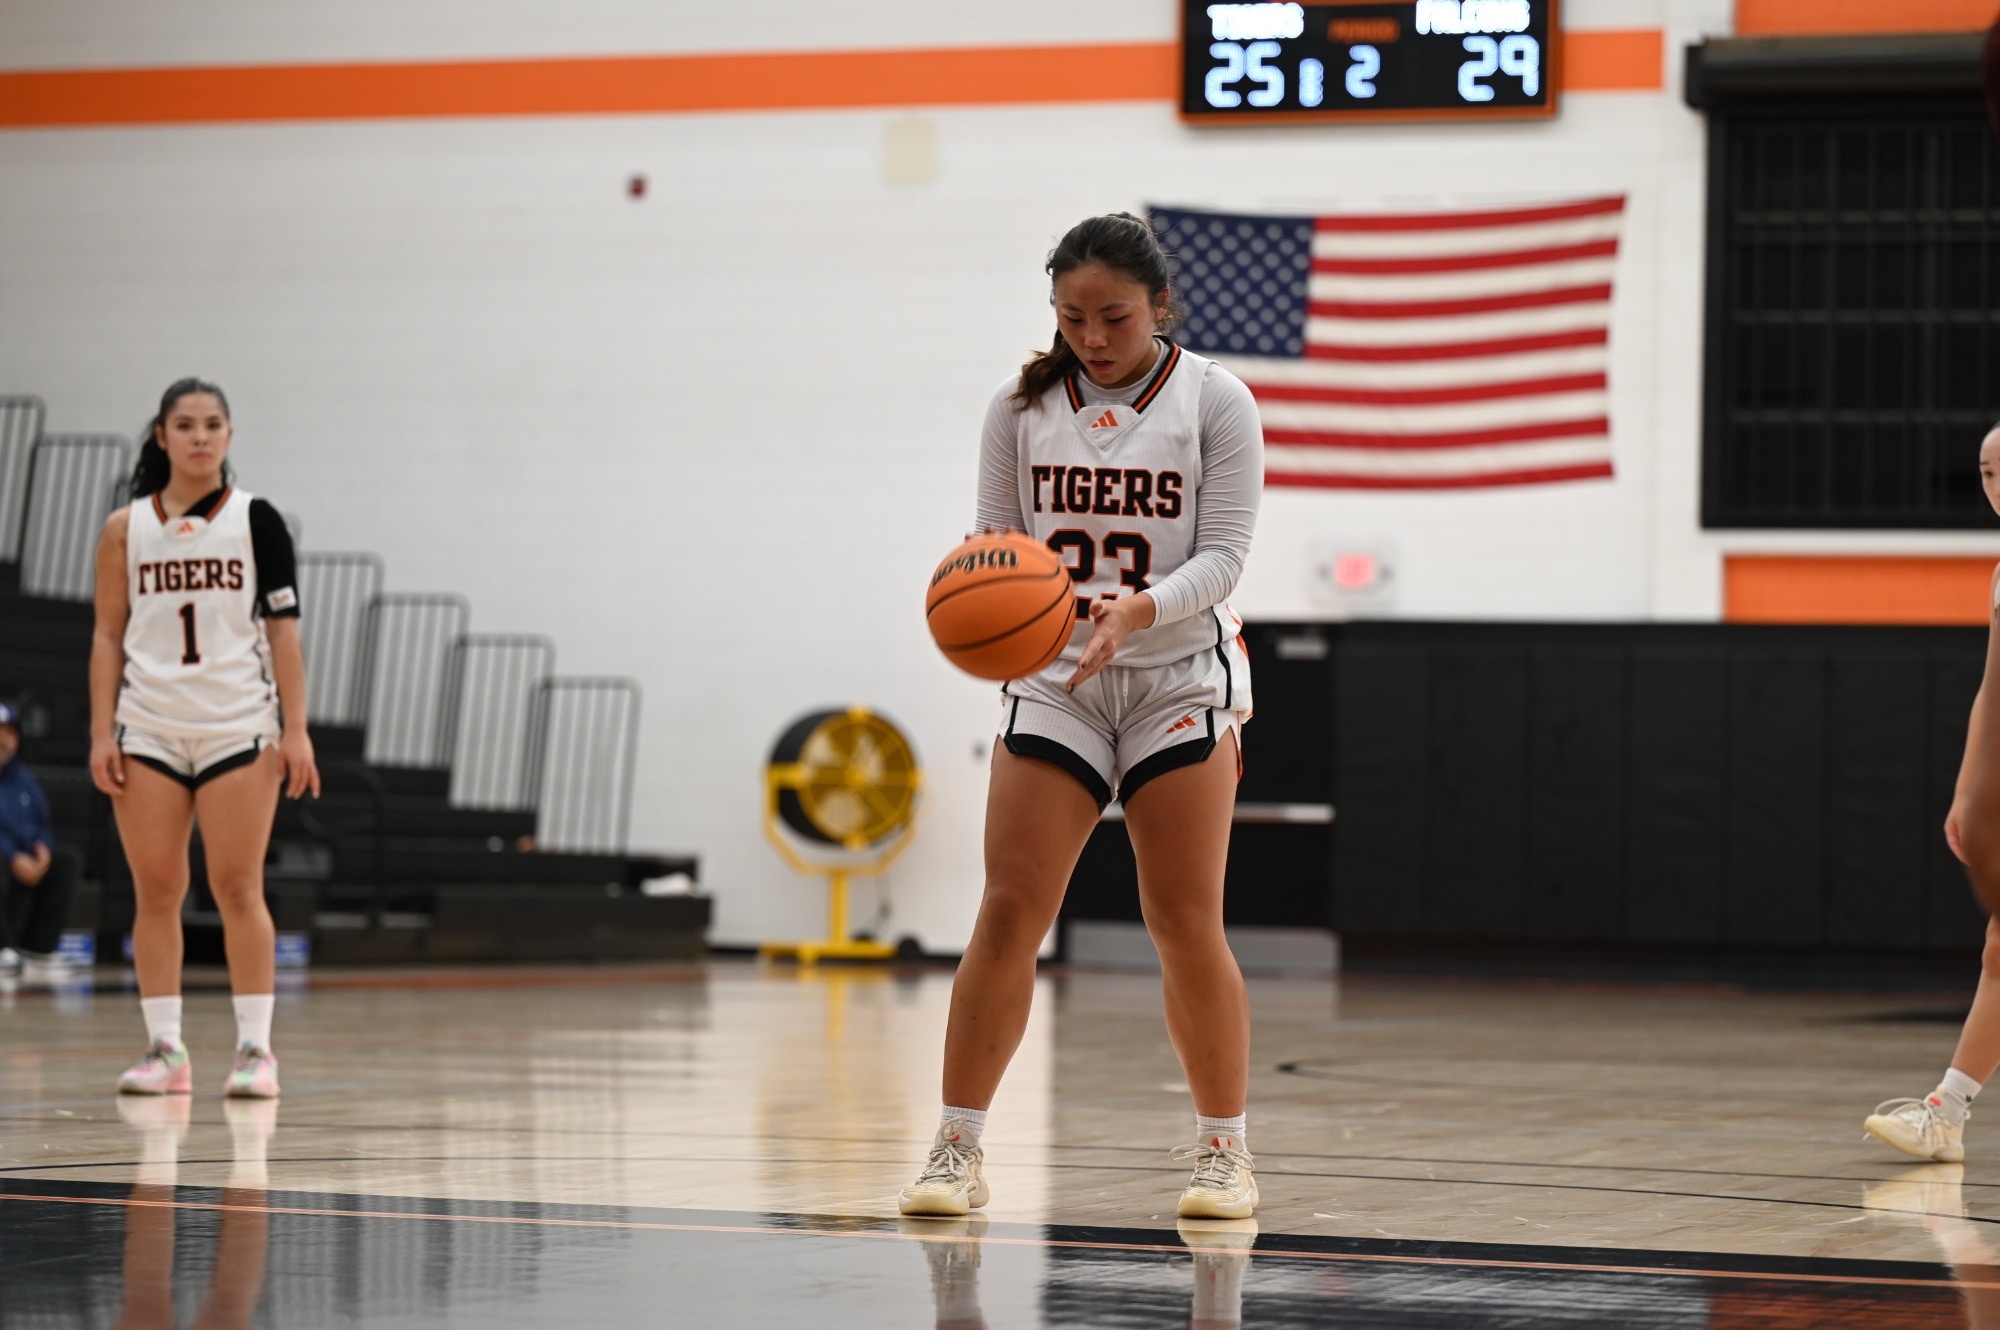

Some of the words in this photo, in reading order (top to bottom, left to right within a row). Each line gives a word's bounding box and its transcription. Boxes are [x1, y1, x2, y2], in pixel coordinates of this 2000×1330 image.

[1204, 42, 1284, 107] 25
[1345, 45, 1380, 98] 2
[1457, 35, 1539, 101] 29
[1031, 464, 1183, 519] TIGERS
[138, 558, 244, 595] TIGERS
[1044, 528, 1152, 621] 23
[178, 601, 201, 666] 1
